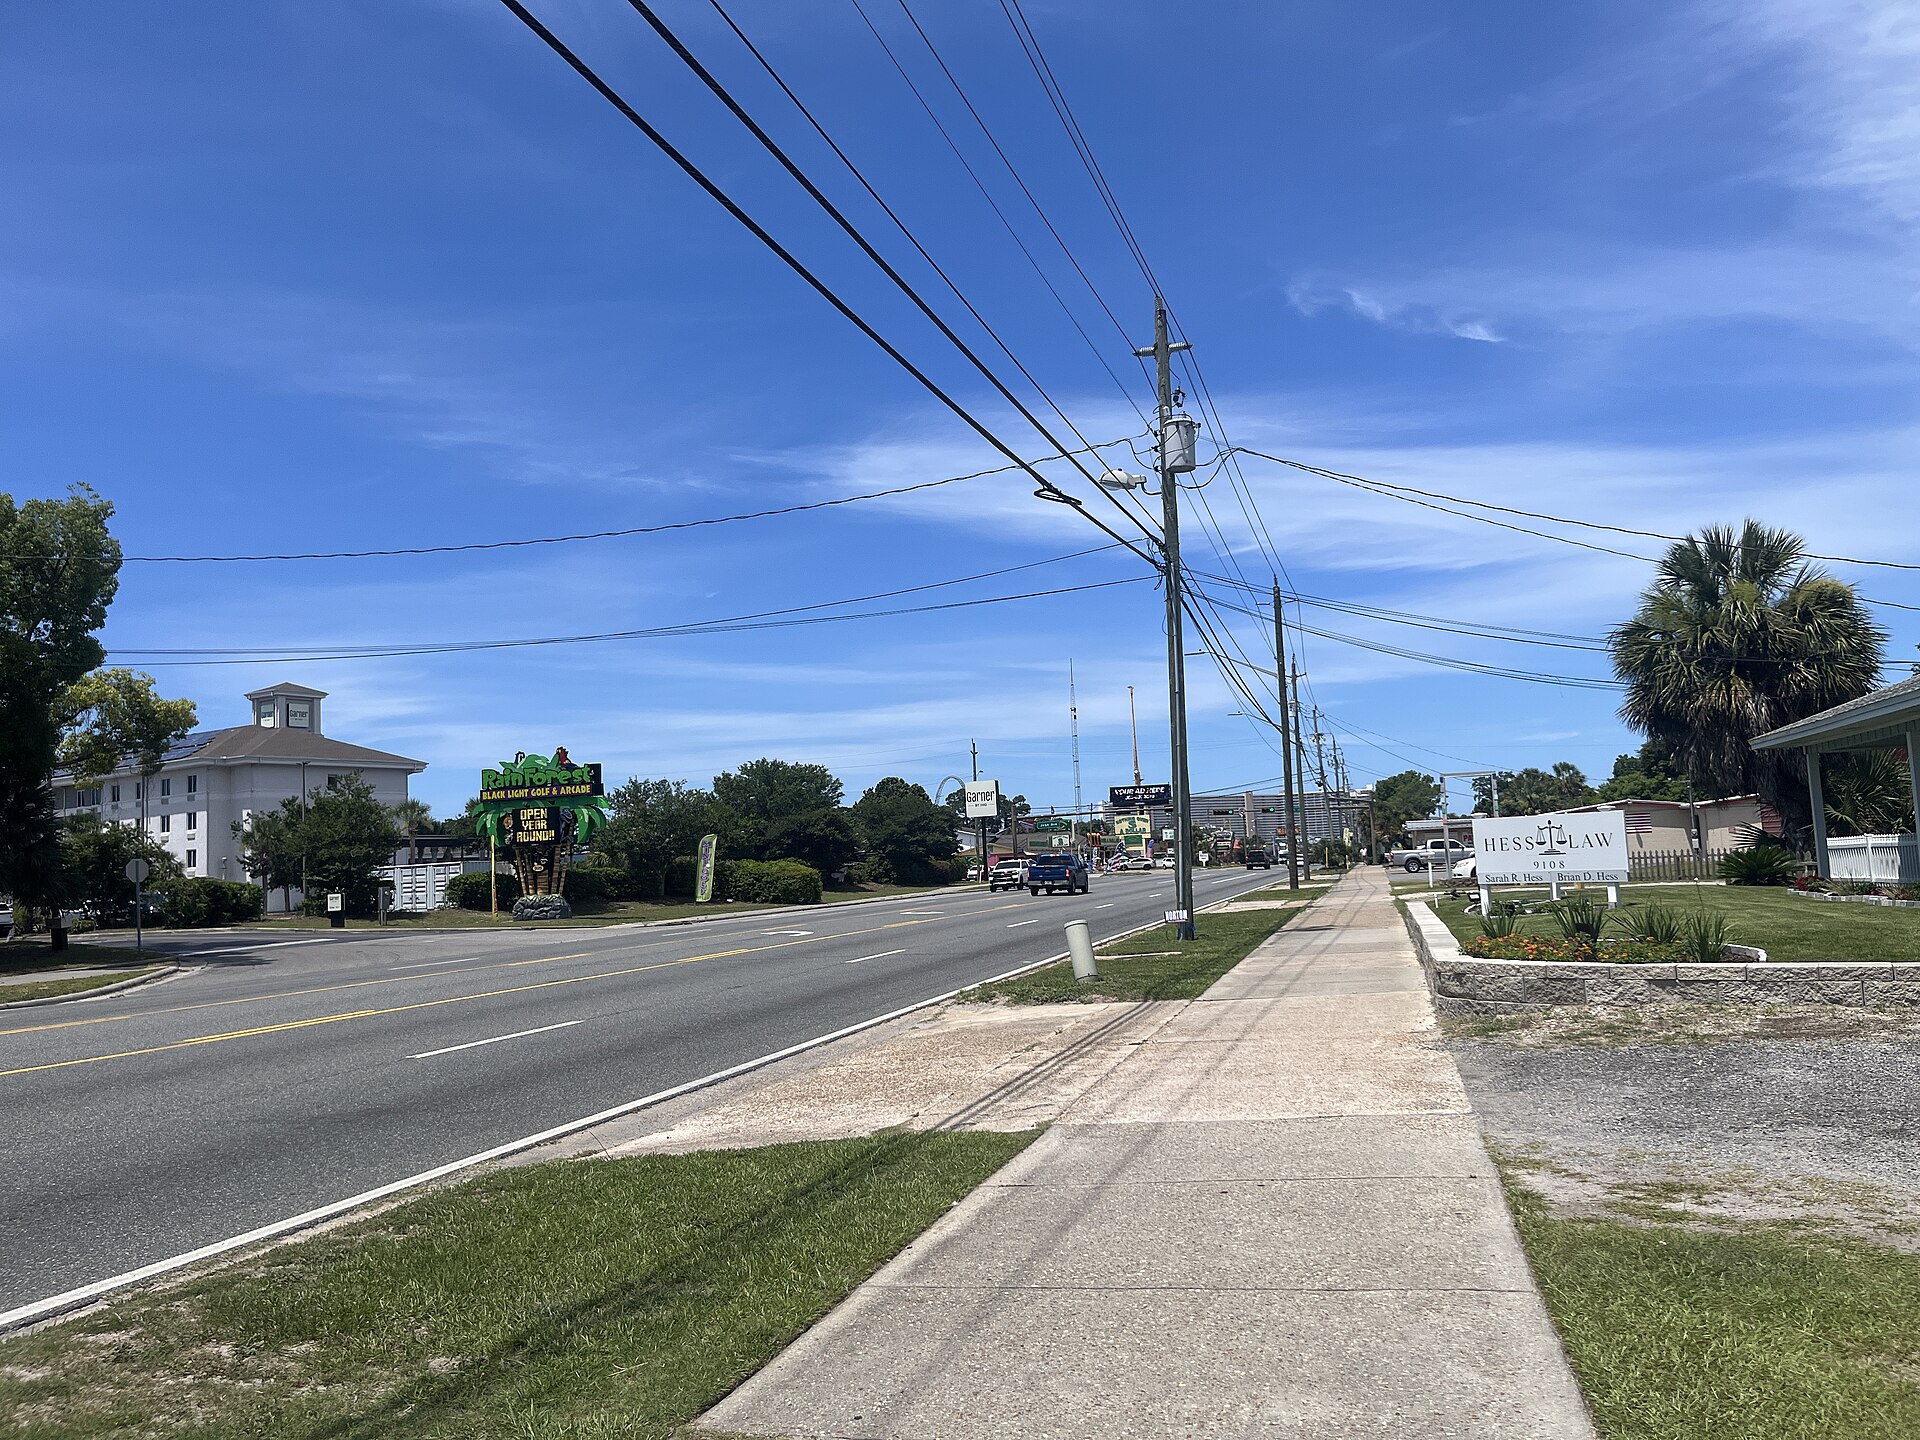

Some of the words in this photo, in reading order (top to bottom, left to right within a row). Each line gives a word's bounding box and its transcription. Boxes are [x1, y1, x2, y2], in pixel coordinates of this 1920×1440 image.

[290, 709, 308, 718] Garner
[482, 792, 506, 800] BLACK
[507, 790, 529, 798] LIGHT
[531, 788, 550, 797] GOLF
[551, 787, 558, 795] &
[560, 785, 591, 794] ARCADE
[966, 790, 995, 803] Garner
[520, 808, 548, 820] OPEN
[521, 820, 547, 830] YEAR
[516, 830, 555, 843] ROUND!!
[1484, 836, 1535, 852] HESS
[1568, 832, 1613, 849] LAW
[1533, 860, 1566, 870] 9108
[1485, 874, 1509, 883] Sarah
[1511, 873, 1521, 882] R.
[1523, 872, 1544, 882] Hess
[1557, 872, 1581, 882] Brian
[1583, 871, 1595, 881] D.
[1596, 870, 1619, 880] Hess
